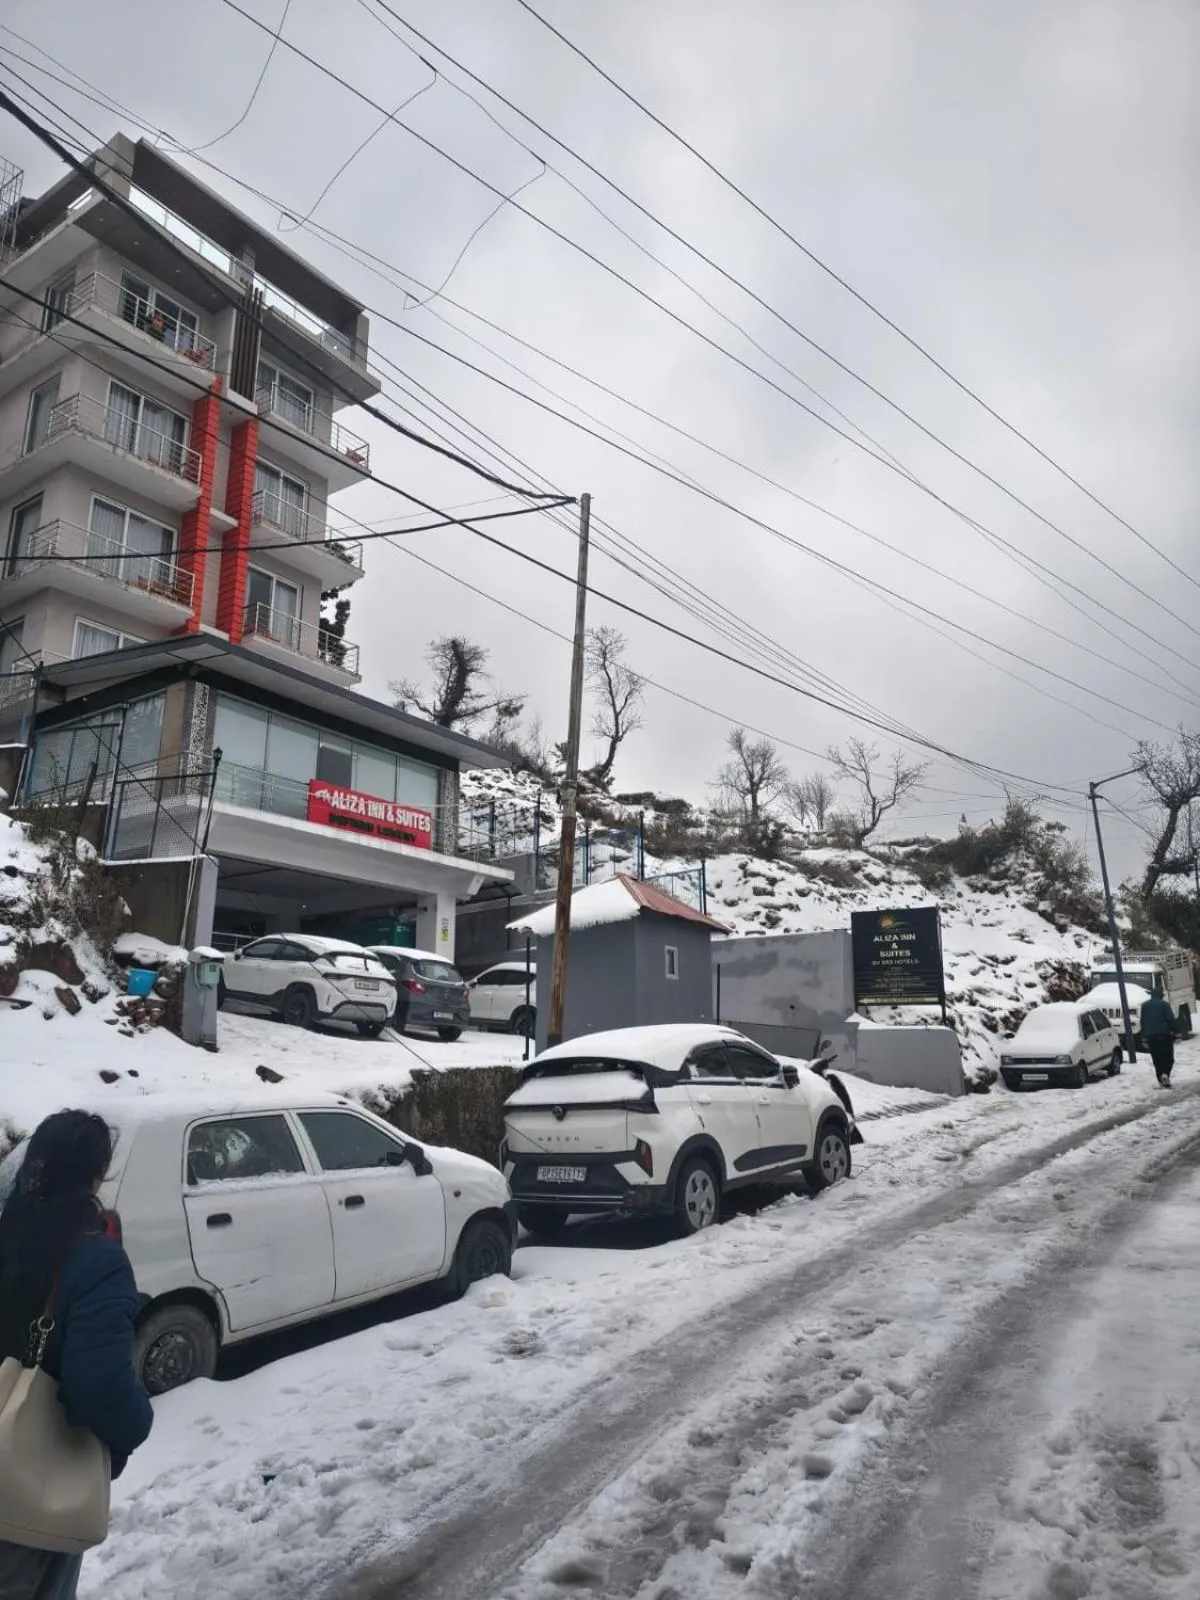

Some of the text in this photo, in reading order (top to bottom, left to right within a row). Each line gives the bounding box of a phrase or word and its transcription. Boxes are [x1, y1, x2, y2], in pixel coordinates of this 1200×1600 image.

[331, 790, 366, 816] ALIZA
[367, 800, 385, 821] INN
[386, 804, 395, 823] &
[395, 808, 431, 833] SUITES
[873, 933, 916, 942] ALIZA INN
[879, 949, 911, 958] SUITES
